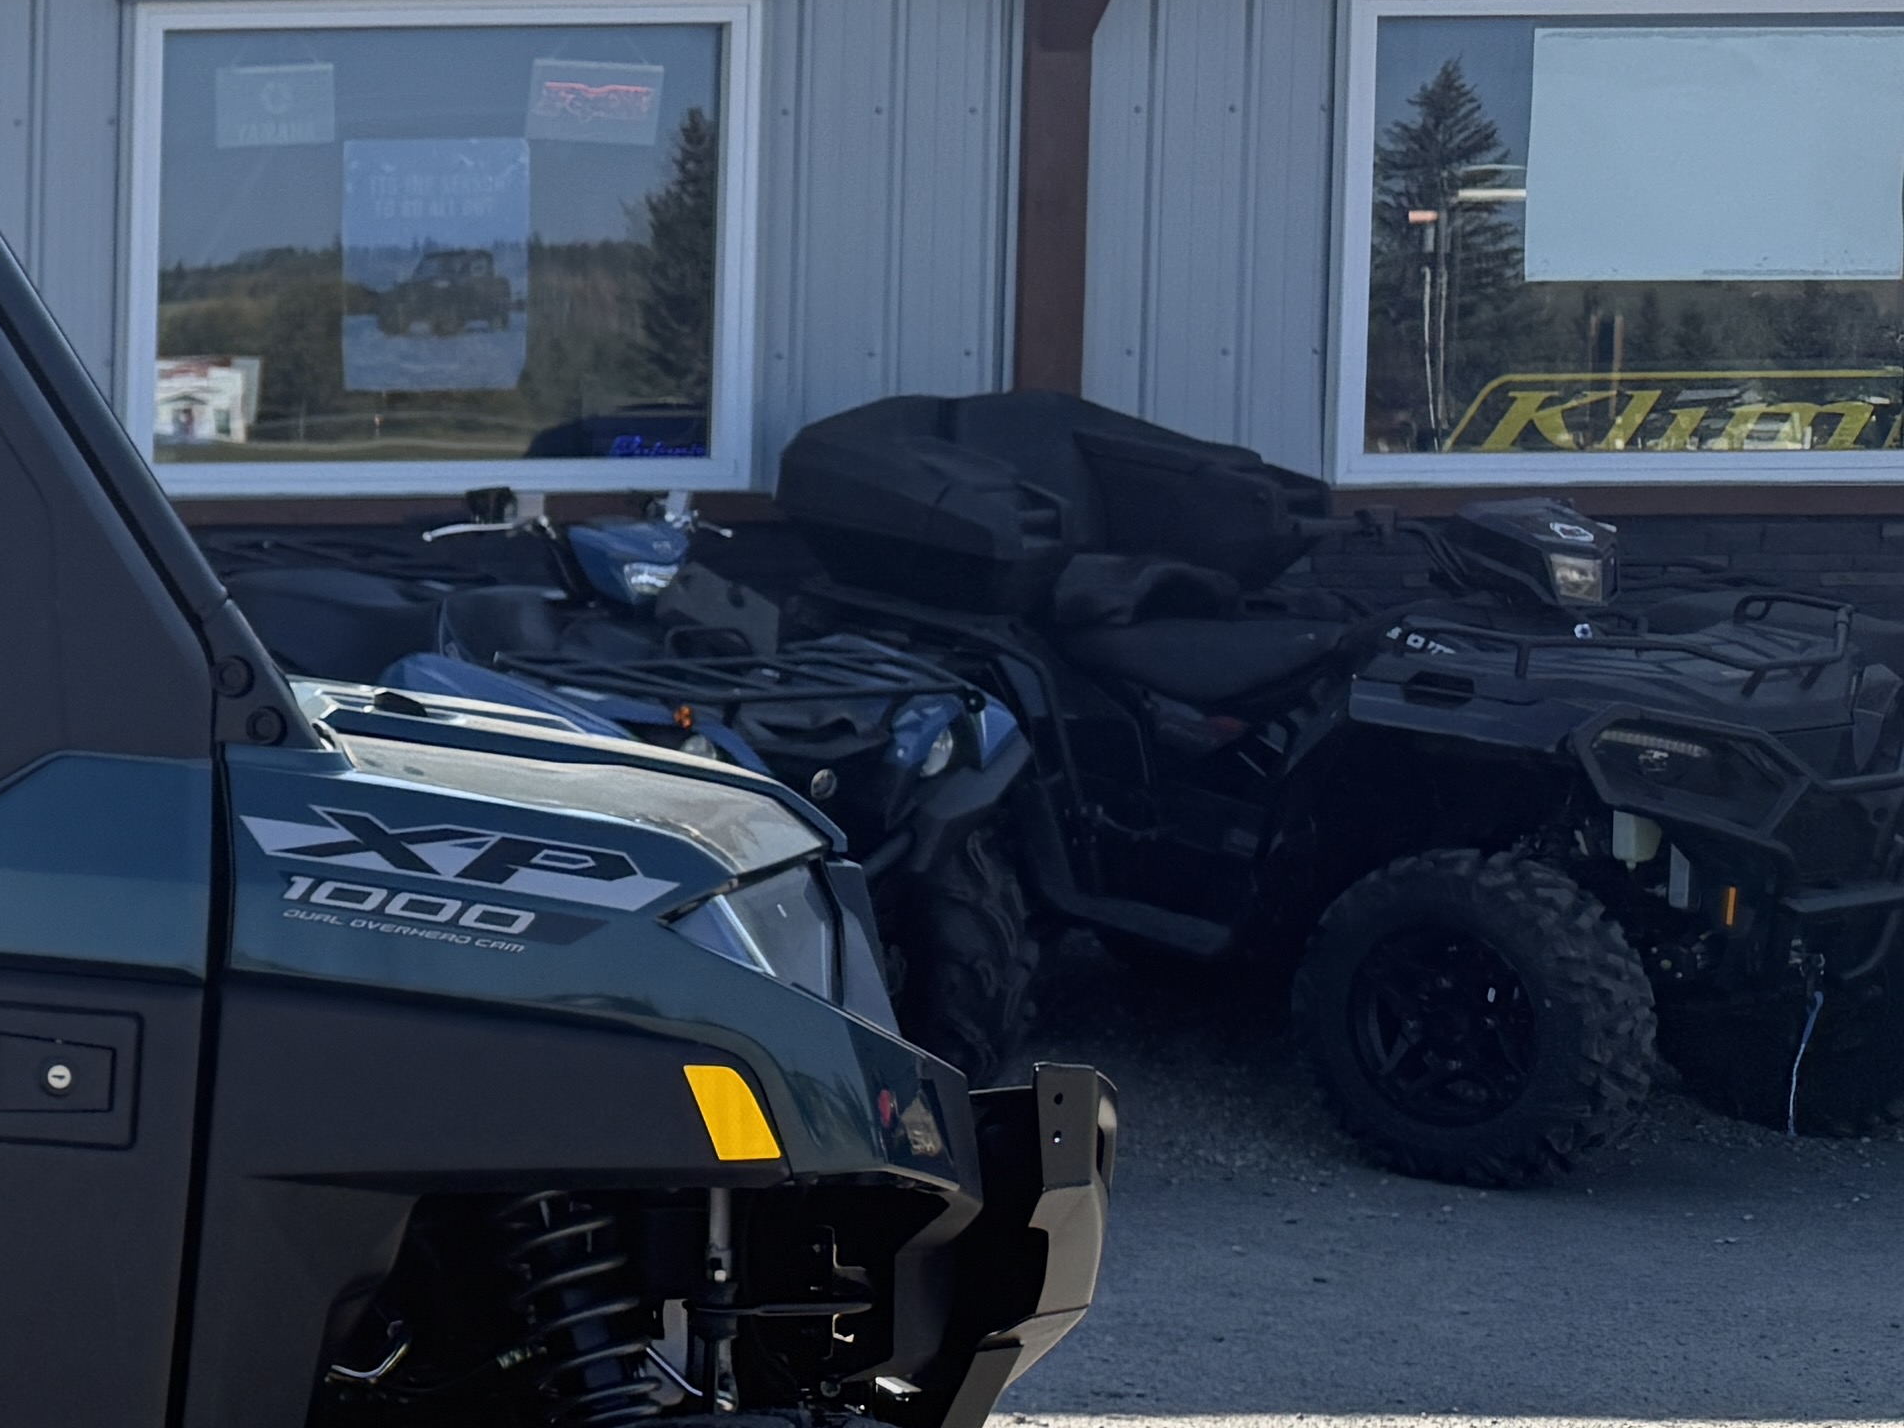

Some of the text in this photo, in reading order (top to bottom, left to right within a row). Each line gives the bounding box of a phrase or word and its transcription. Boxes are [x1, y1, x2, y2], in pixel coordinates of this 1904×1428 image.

[272, 804, 643, 885] XP
[282, 875, 536, 935] 1000
[283, 908, 525, 954] DUAL OVERHEAD CAM
